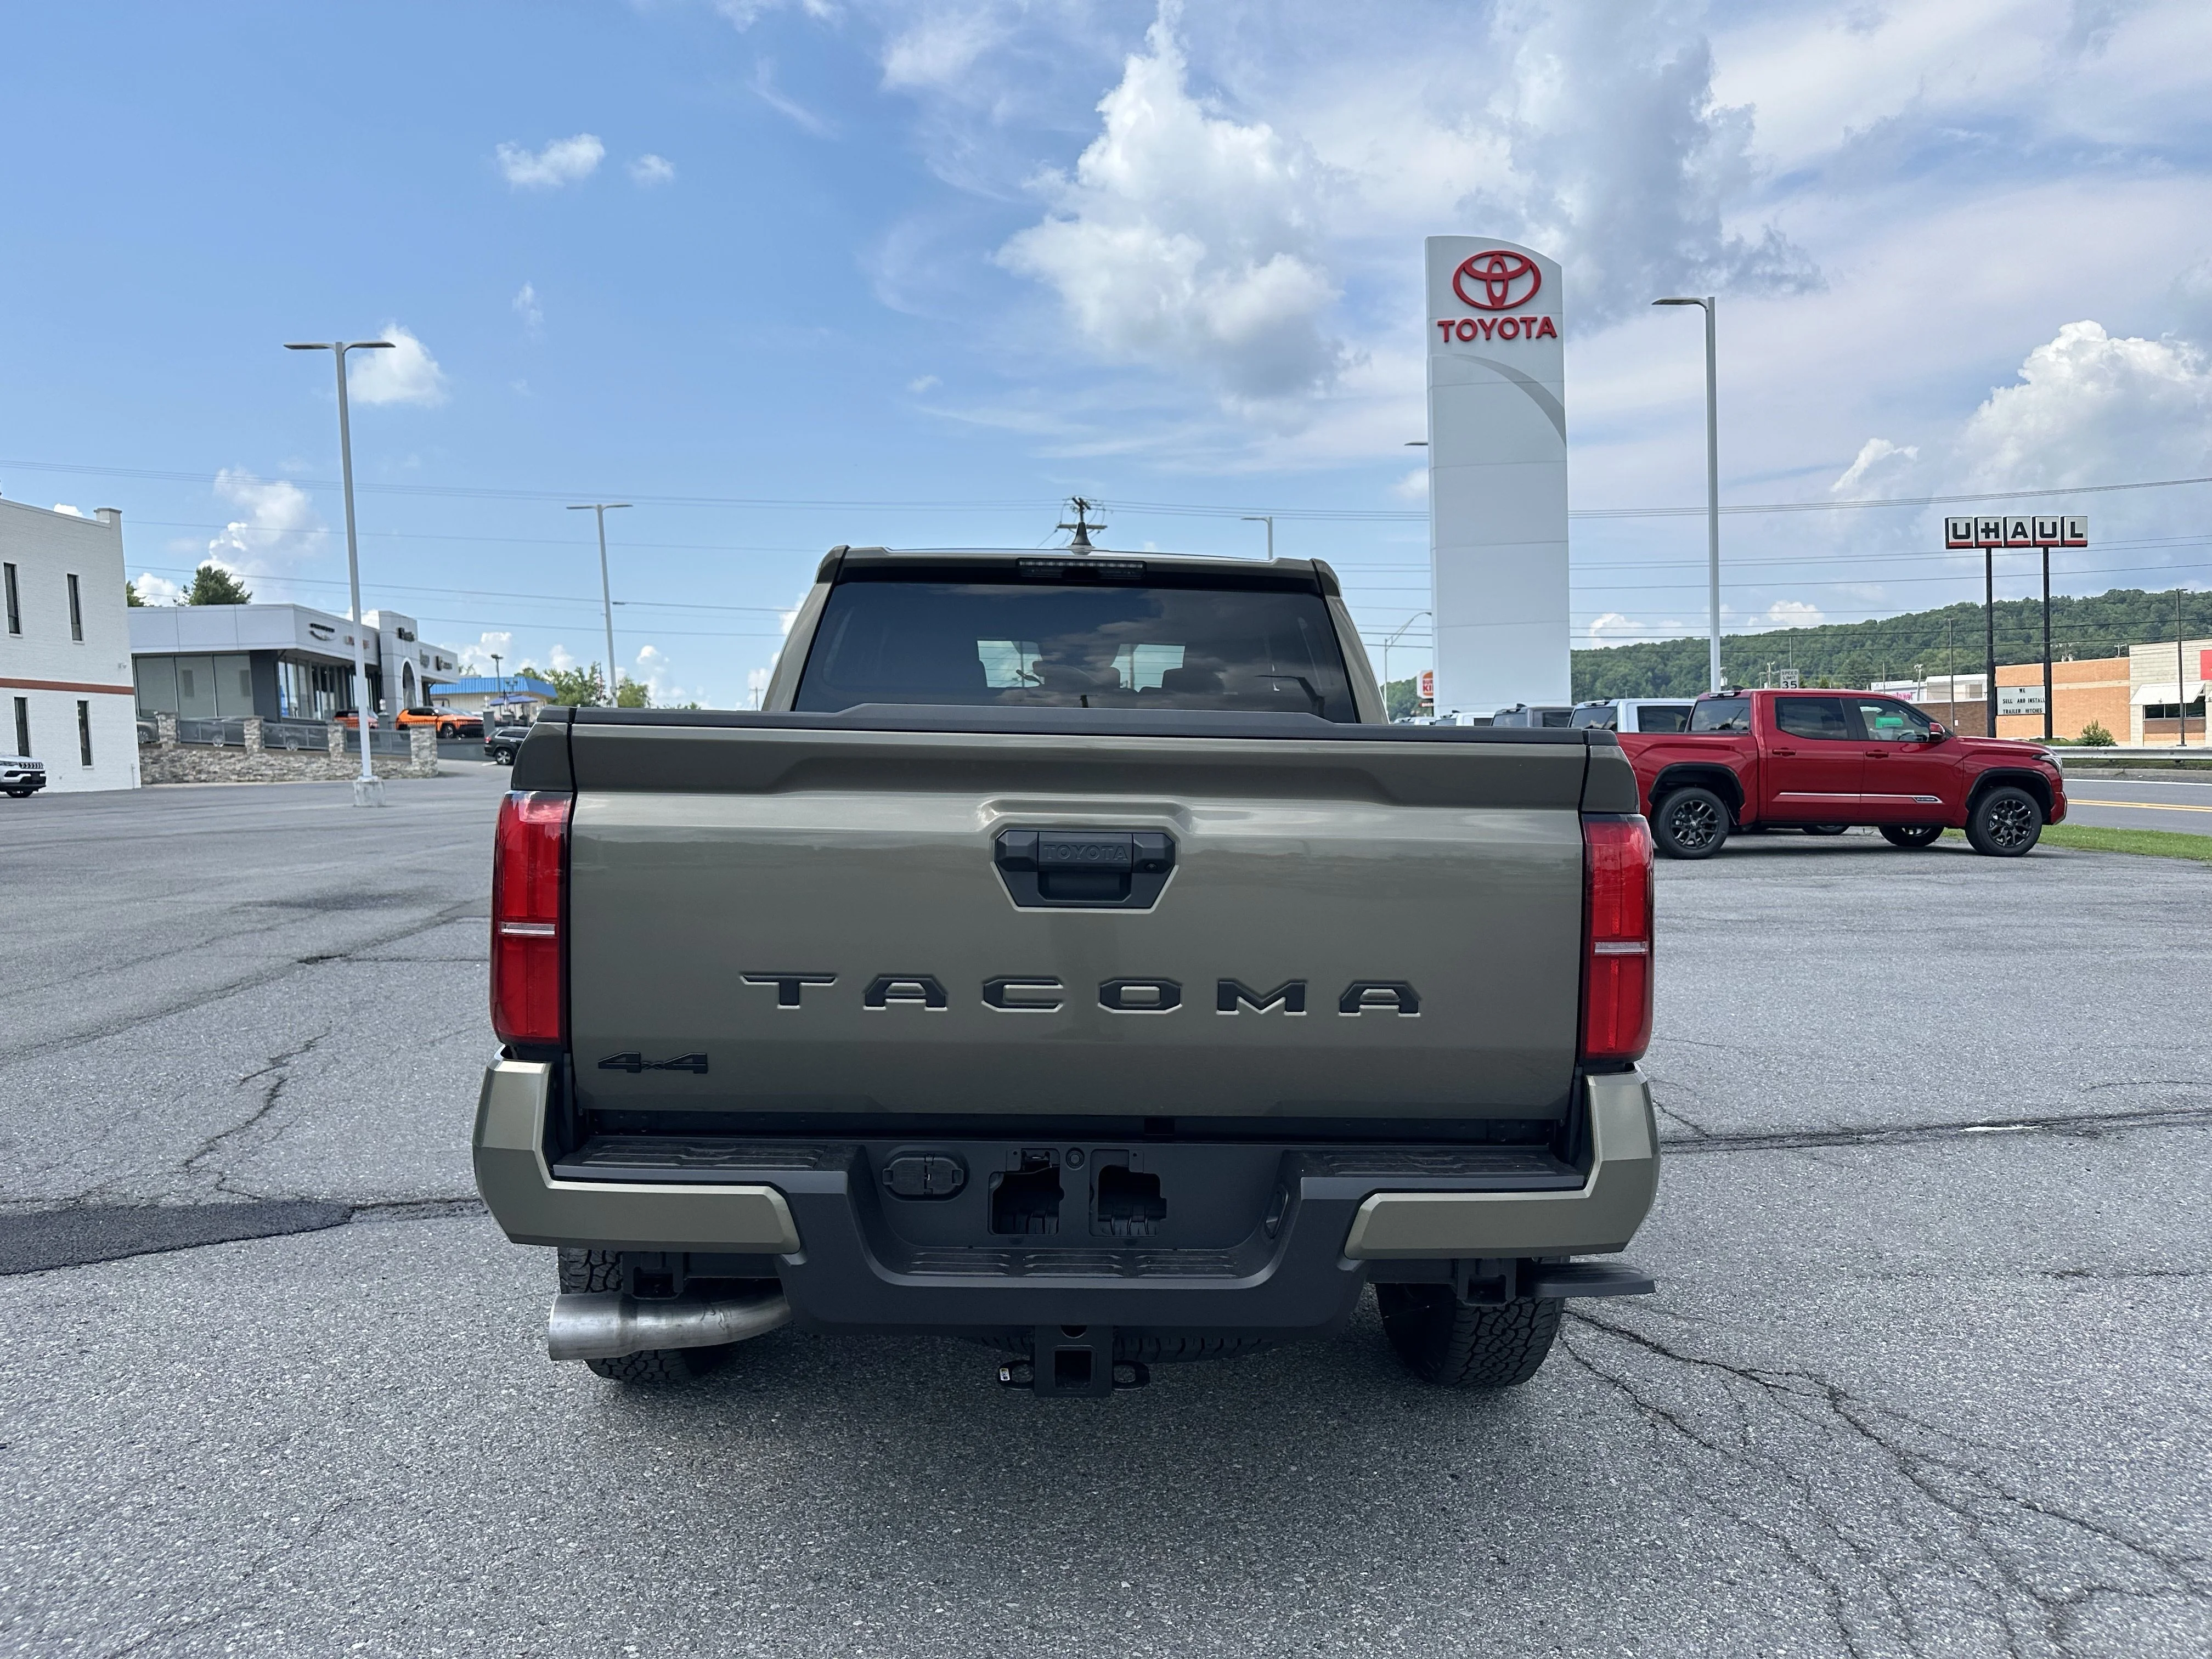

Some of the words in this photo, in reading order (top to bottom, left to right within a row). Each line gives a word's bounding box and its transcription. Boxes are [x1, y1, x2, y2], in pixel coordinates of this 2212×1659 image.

[1437, 317, 1558, 342] TOYOTA
[1043, 844, 1128, 861] TOYOTA
[740, 973, 1421, 1017] TACOMA
